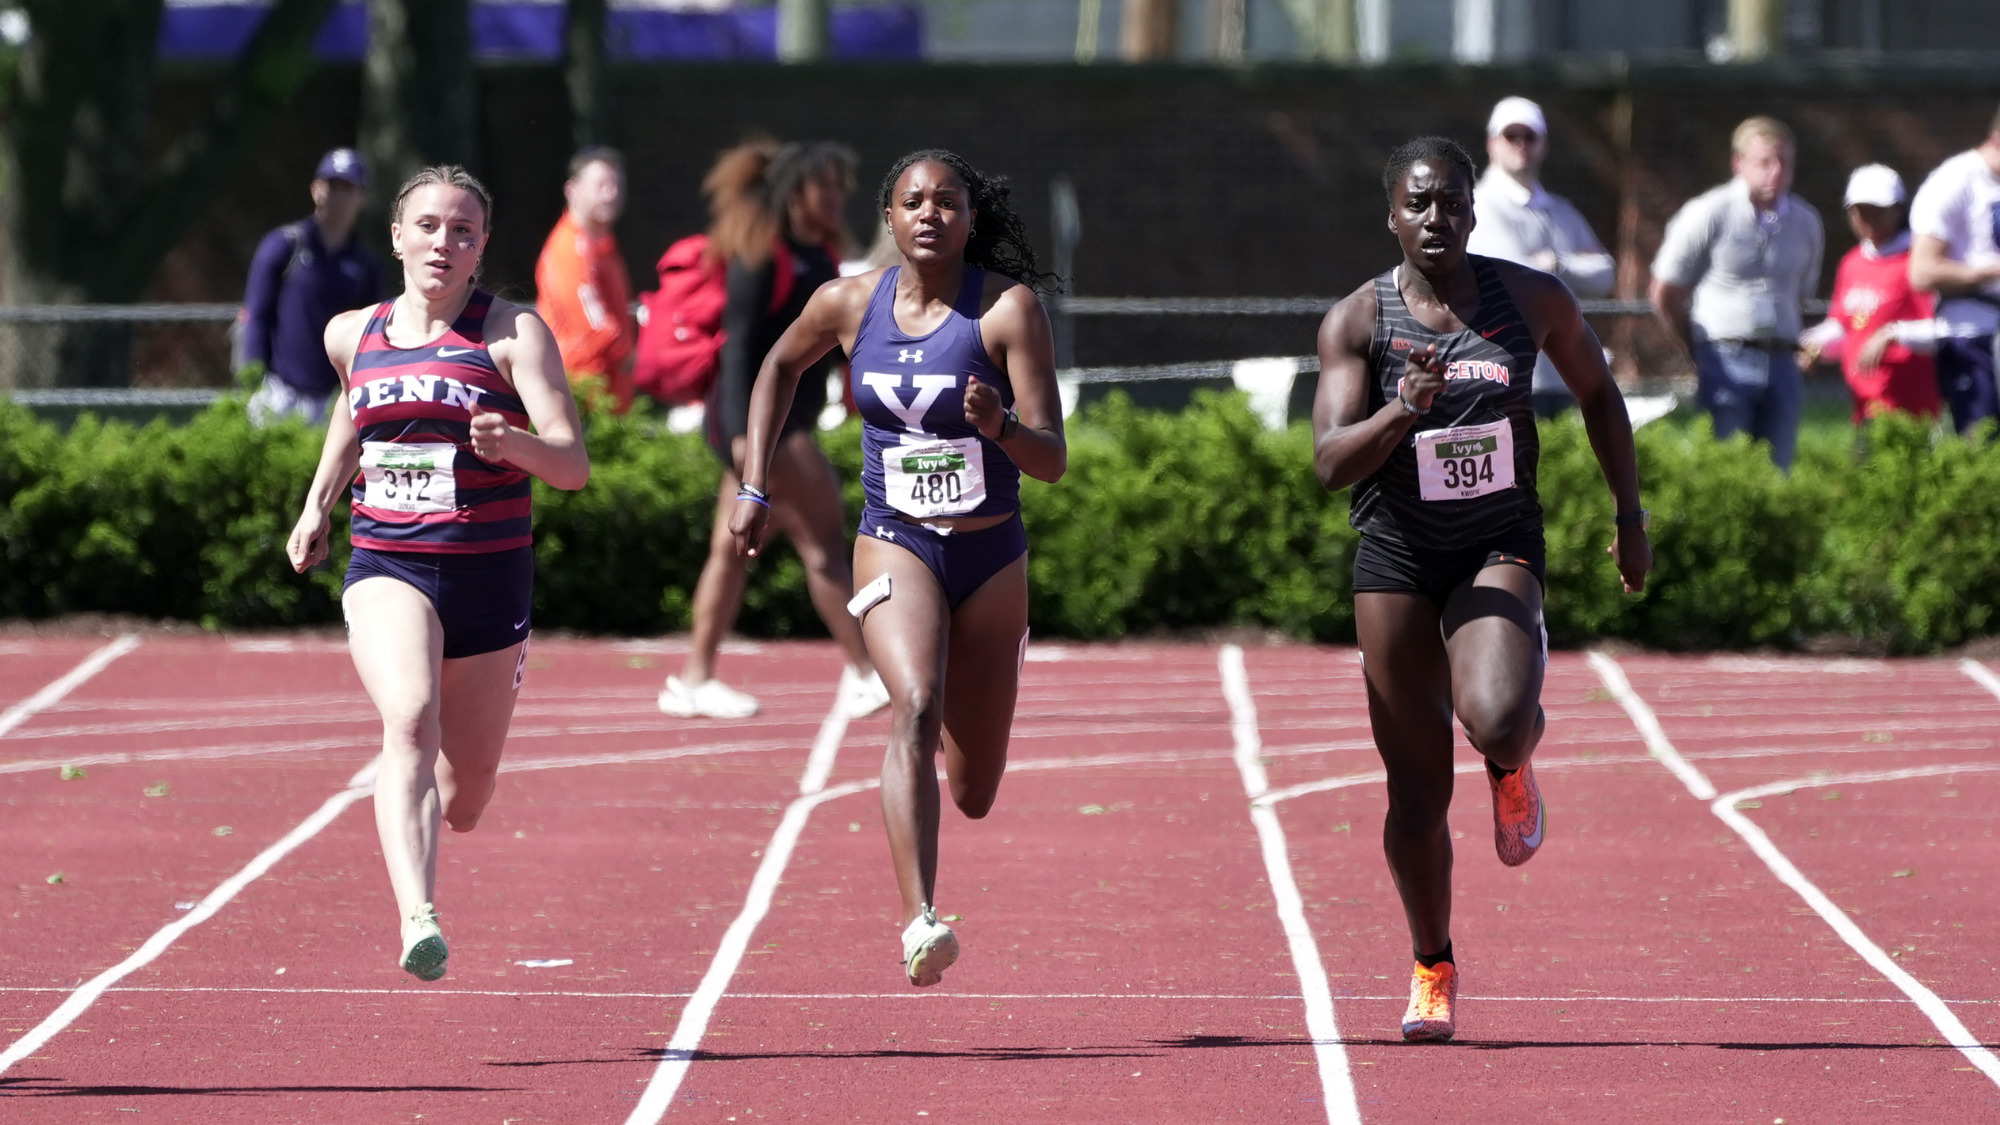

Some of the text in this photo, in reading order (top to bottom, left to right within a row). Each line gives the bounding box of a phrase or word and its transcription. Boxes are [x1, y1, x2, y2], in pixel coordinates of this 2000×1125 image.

[348, 374, 487, 421] PENN
[862, 372, 956, 444] Y
[917, 458, 938, 471] Ivy
[1452, 443, 1473, 456] Ivy
[384, 469, 431, 501] 312
[1443, 454, 1494, 489] 394
[911, 472, 961, 505] 480
